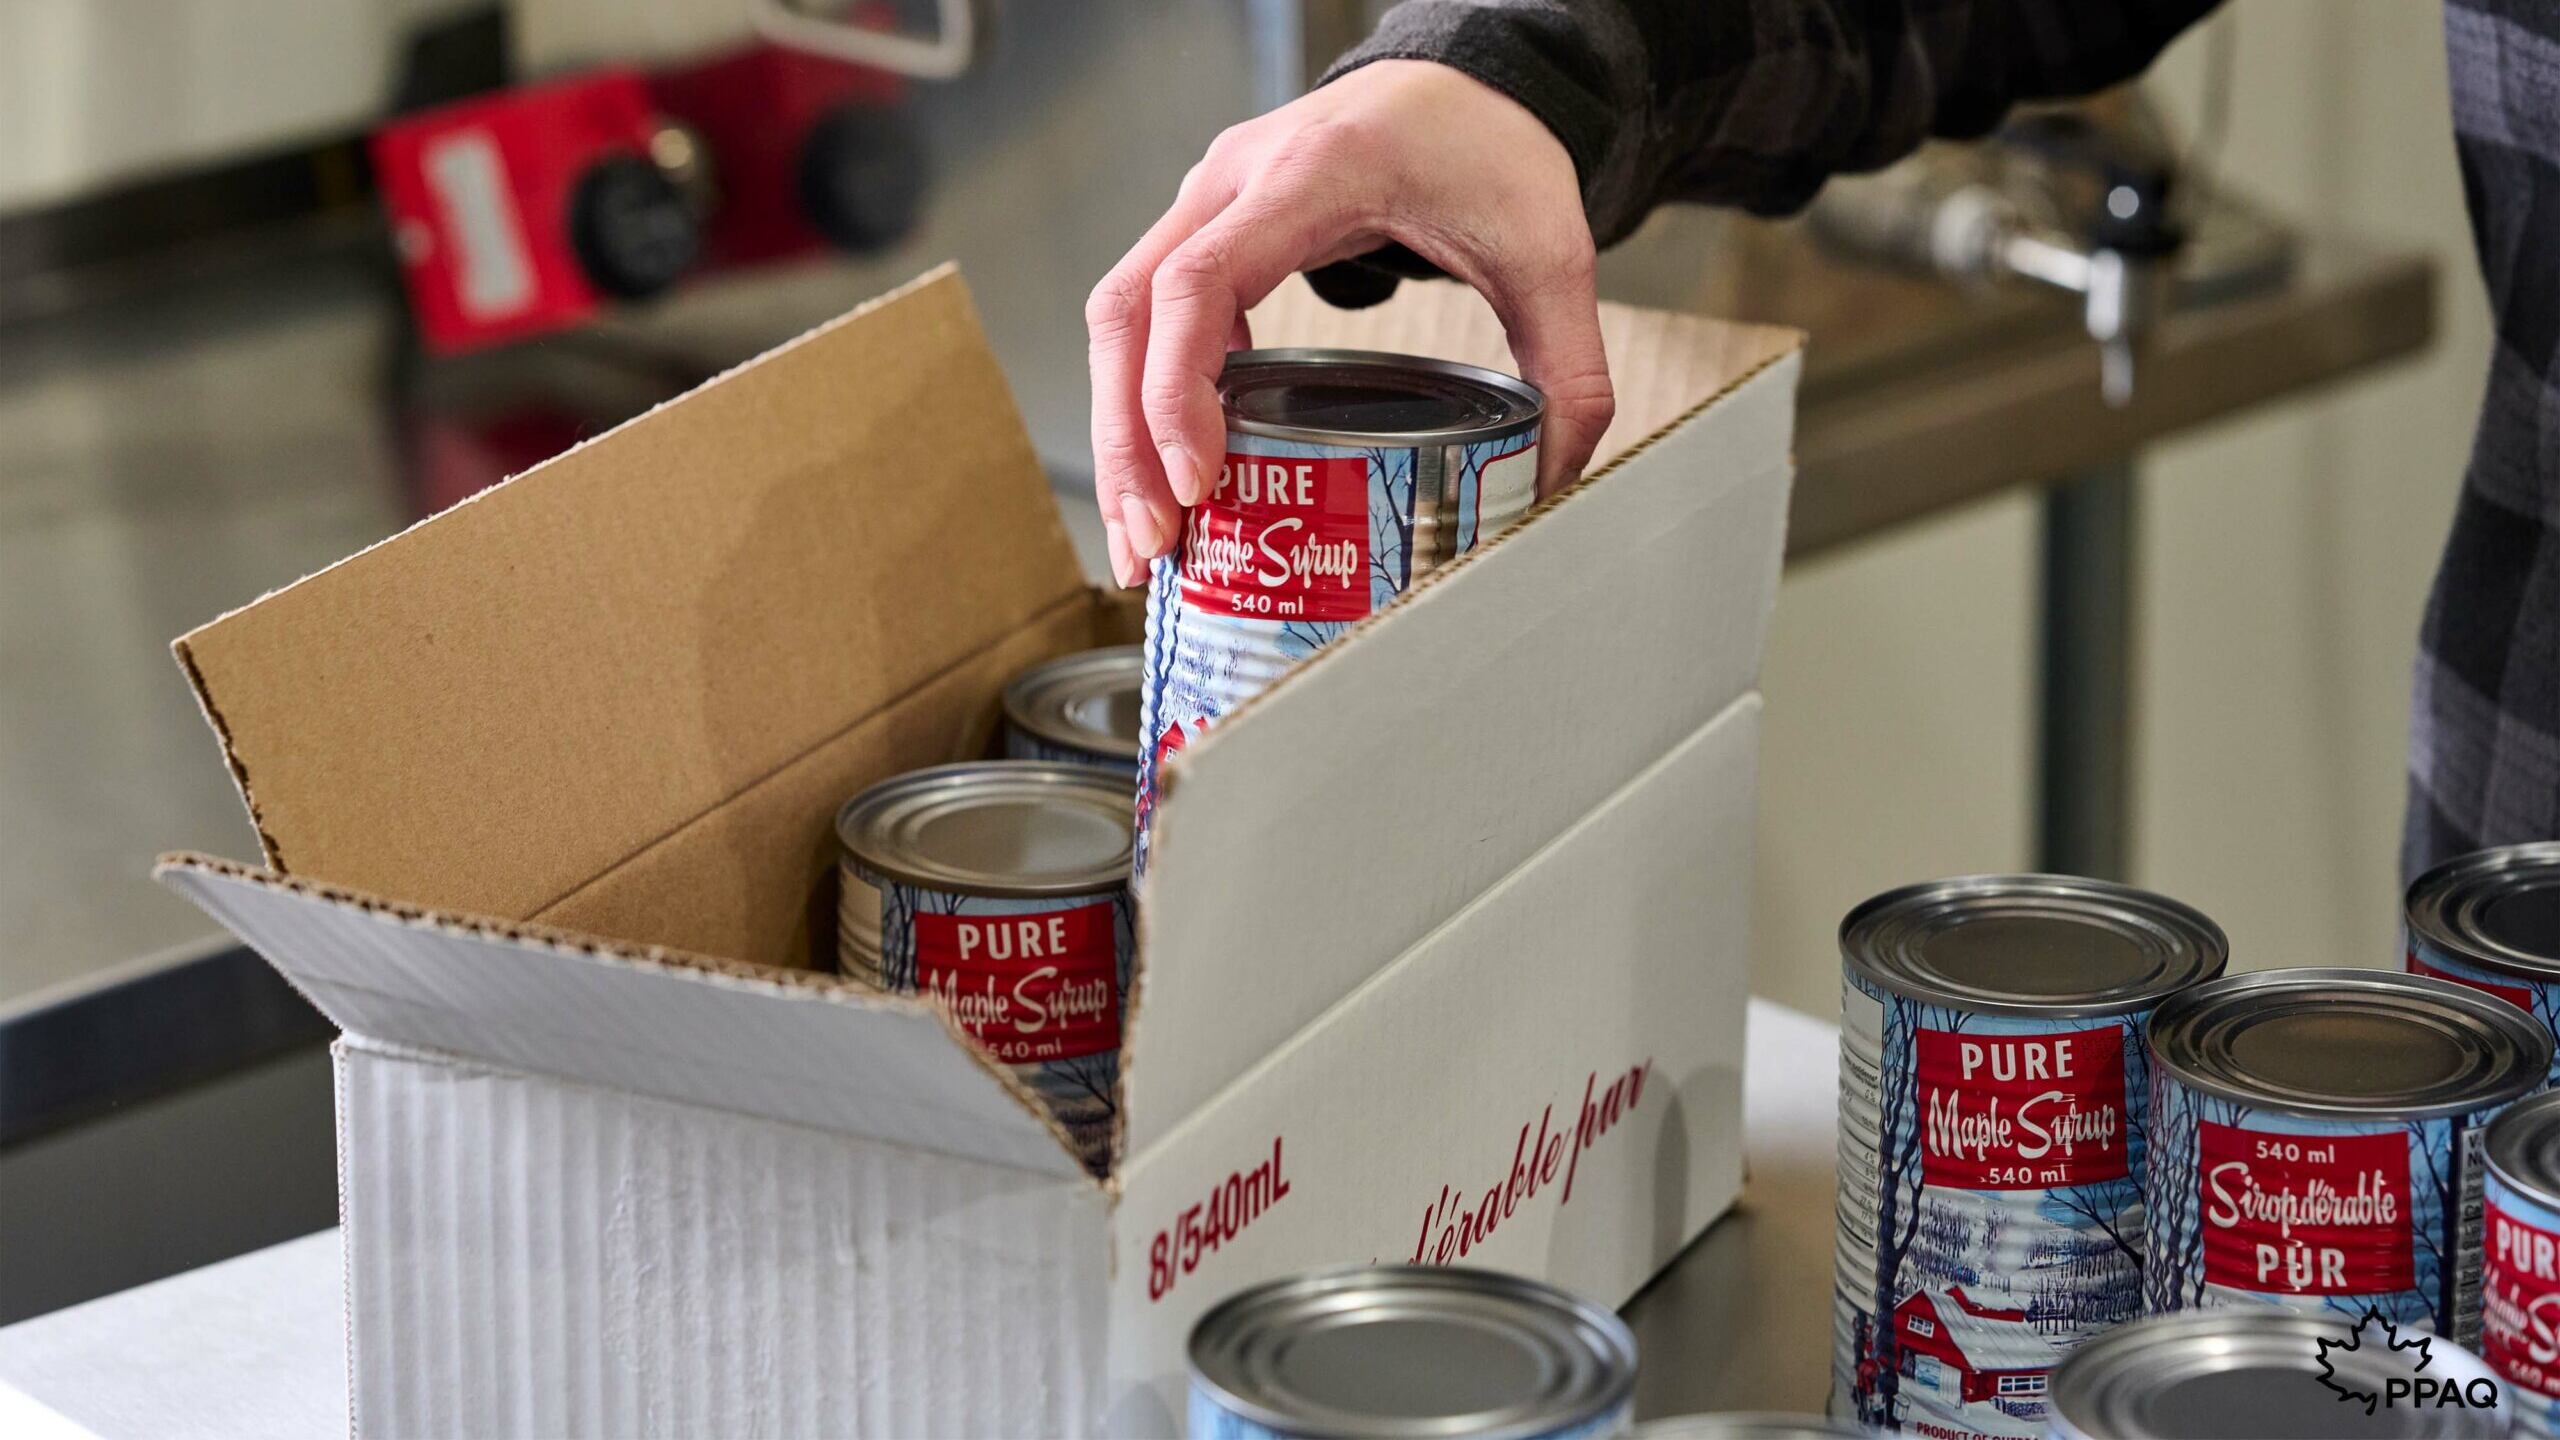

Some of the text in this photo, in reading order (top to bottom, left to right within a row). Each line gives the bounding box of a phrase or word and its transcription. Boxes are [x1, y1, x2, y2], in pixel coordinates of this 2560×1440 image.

[1213, 464, 1315, 506] PURE
[1185, 507, 1359, 589] Maple Syrup
[1231, 593, 1304, 615] 540 ml
[957, 916, 1068, 961] PURE
[928, 966, 1108, 1038] Maple Syrup
[1036, 1037, 1062, 1057] ml
[1960, 1039, 2075, 1082] PURE
[1561, 1056, 1653, 1207] par
[1927, 1087, 2116, 1163] Maple Syrup
[1988, 1163, 2067, 1185] 540 ml
[2255, 1140, 2335, 1164] 540 ml
[1148, 1136, 1291, 1302] 8/540mL
[2208, 1161, 2299, 1238] Sirop
[2255, 1243, 2347, 1288] PUR
[2496, 1218, 2560, 1282] PUR
[1915, 1421, 1969, 1440] PRODUCT
